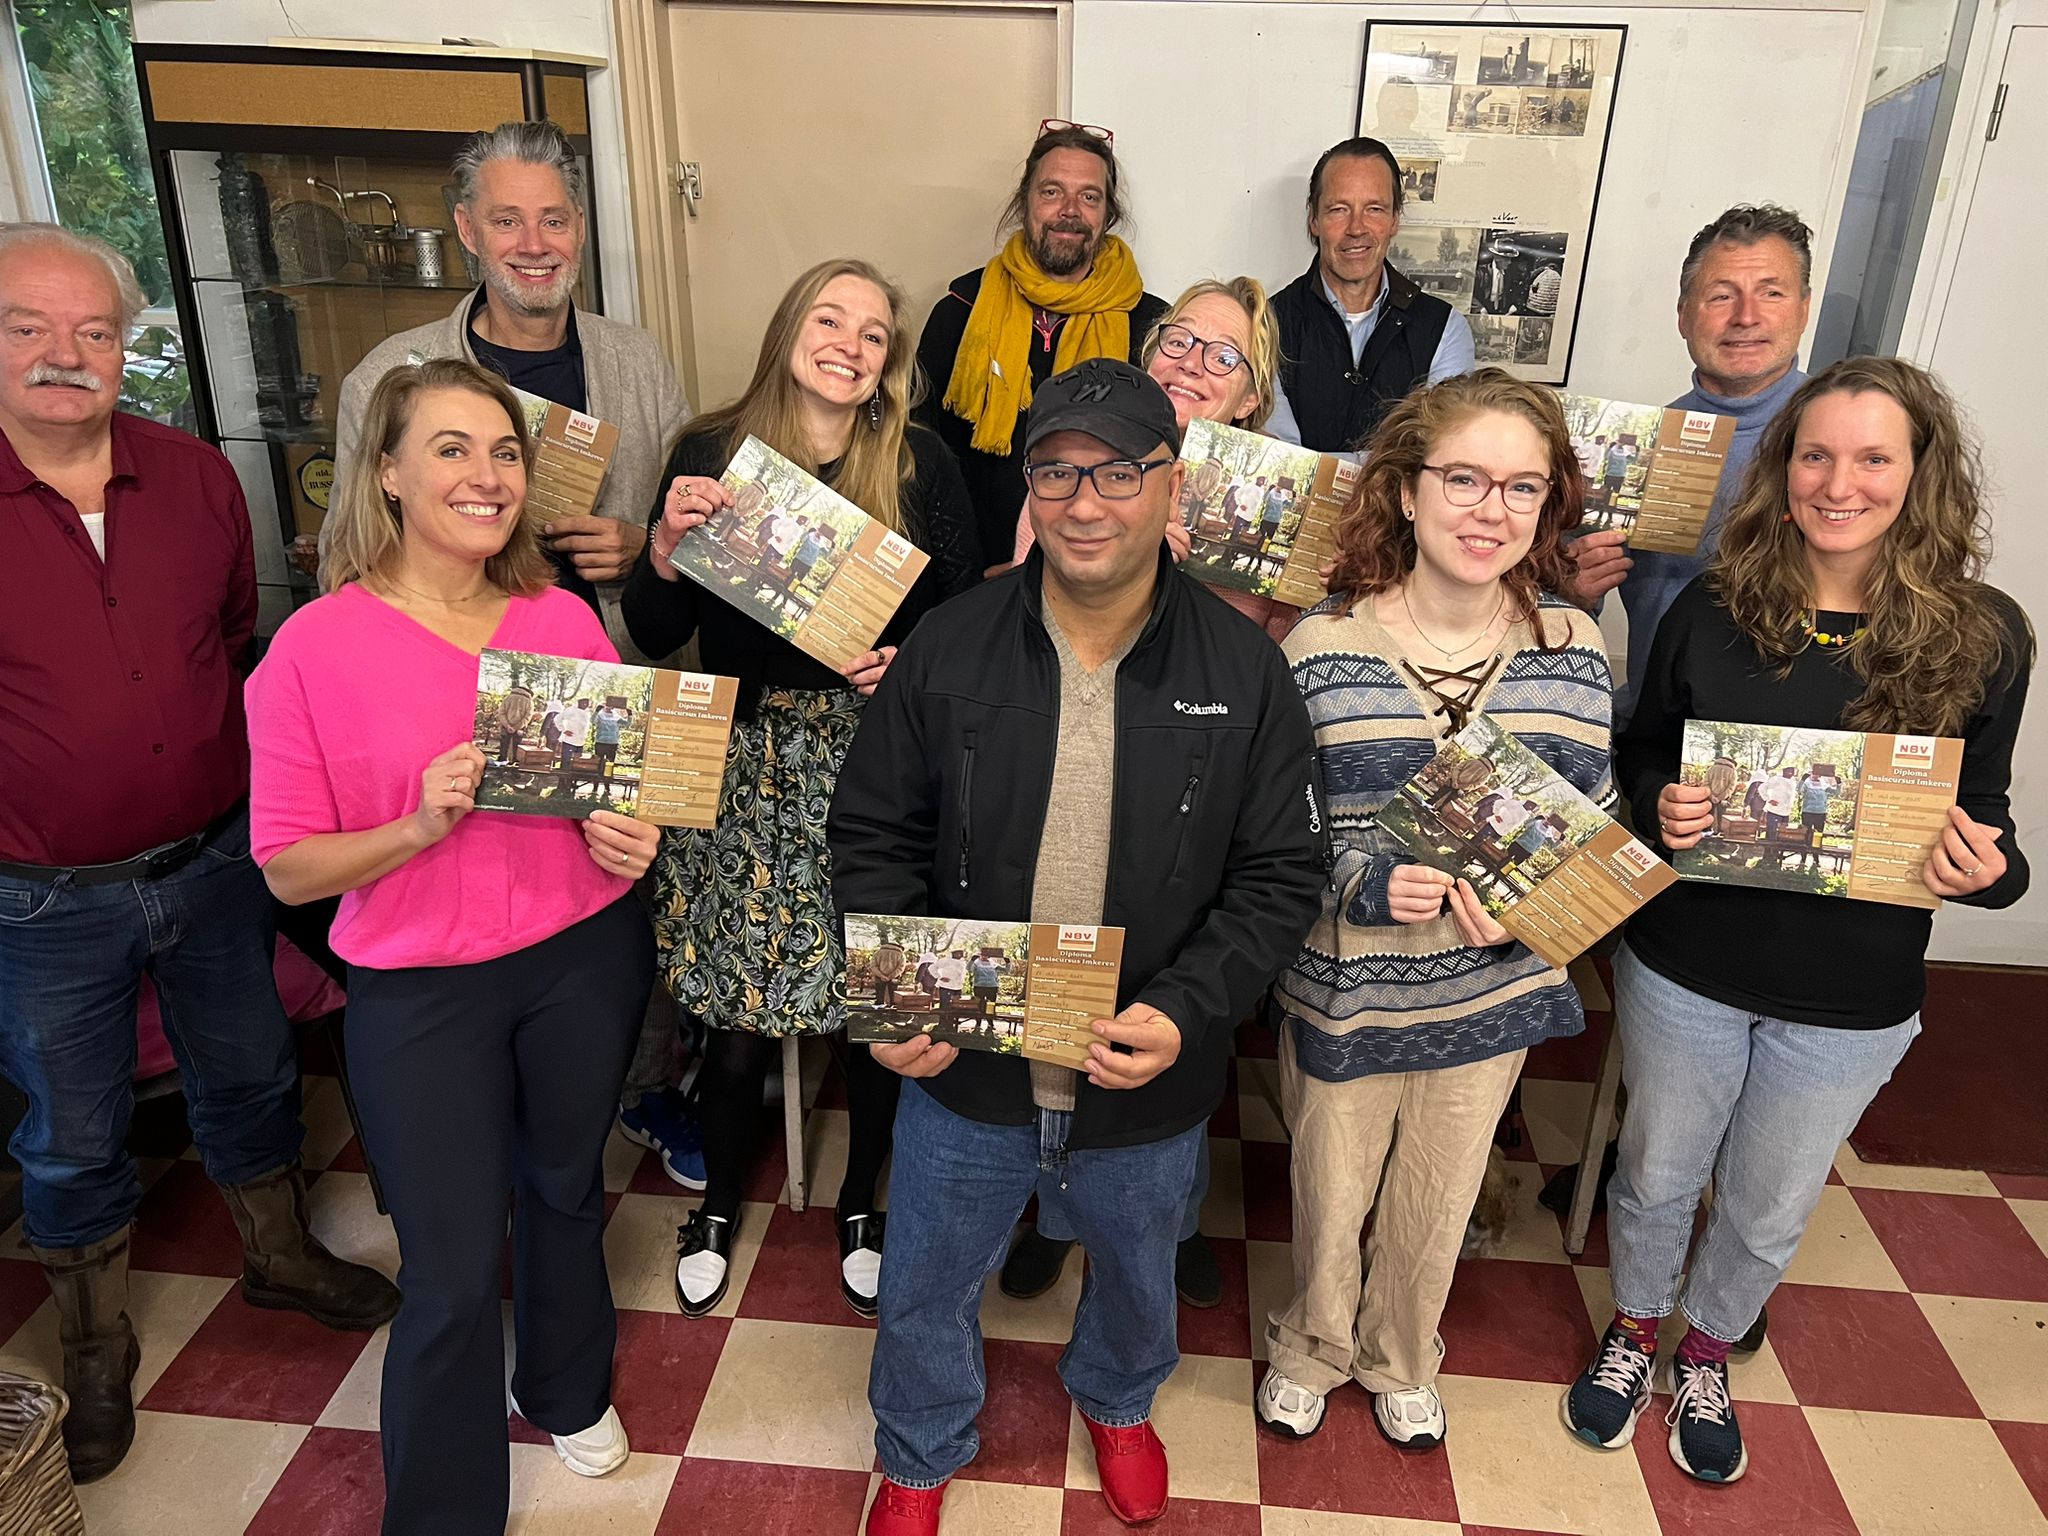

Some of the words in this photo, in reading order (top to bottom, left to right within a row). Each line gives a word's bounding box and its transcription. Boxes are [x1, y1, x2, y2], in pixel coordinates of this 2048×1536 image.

[572, 419, 594, 431] NBV
[1687, 419, 1711, 429] NBV
[886, 539, 907, 555] NBV
[684, 680, 710, 690] NBV
[678, 702, 708, 711] Diploma
[1181, 702, 1229, 715] Columbia
[656, 707, 697, 718] Basiscursus
[697, 712, 728, 721] Imkeren
[1899, 744, 1929, 754] NBV
[1893, 768, 1928, 777] Diploma
[1867, 774, 1915, 785] Basiscursus
[1916, 779, 1953, 788] Imkeren
[1305, 783, 1321, 834] Columbia
[1626, 846, 1651, 866] NBV
[1584, 849, 1620, 880] Basiscursus
[1618, 877, 1644, 901] Imkeren
[1607, 858, 1633, 882] Diploma
[1064, 932, 1092, 940] NBV
[1060, 950, 1092, 958] Diploma
[1035, 955, 1080, 964] Basiscursus
[1082, 958, 1115, 967] Imkeren
